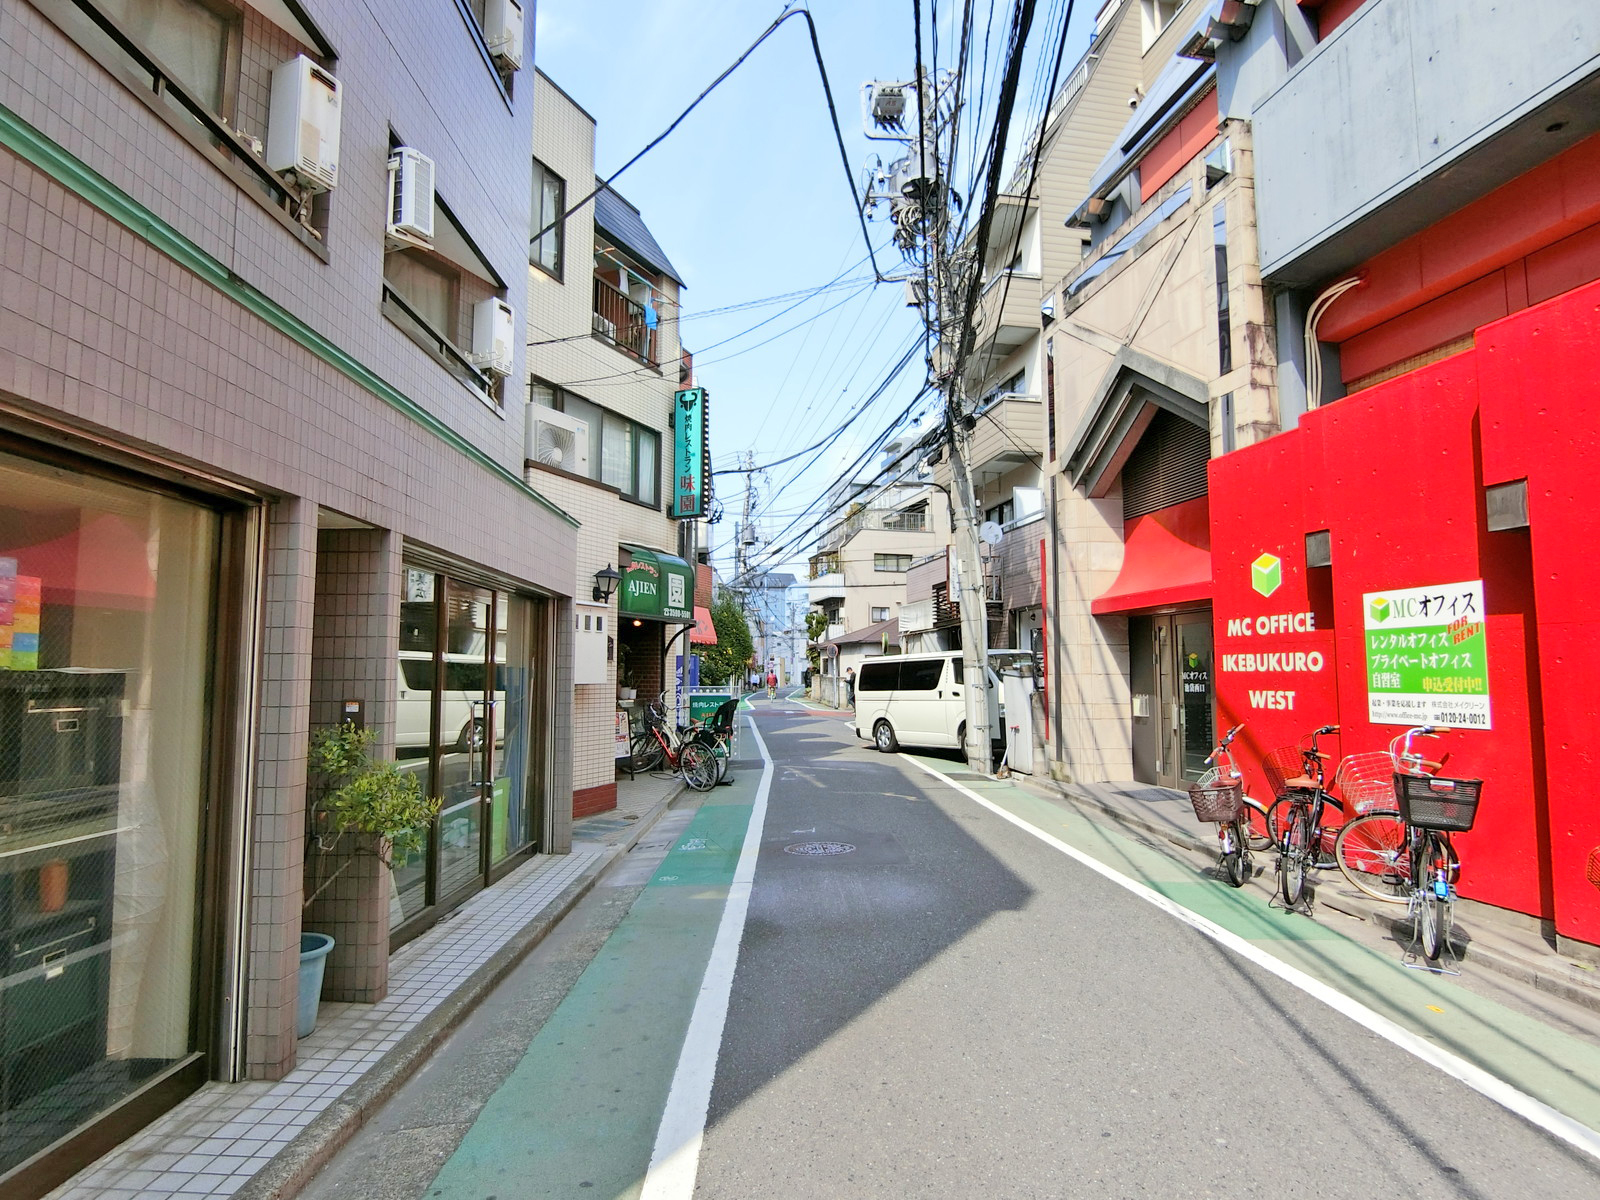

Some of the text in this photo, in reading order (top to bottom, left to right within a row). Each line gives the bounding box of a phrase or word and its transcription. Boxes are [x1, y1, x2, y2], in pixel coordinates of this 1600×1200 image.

[680, 414, 696, 514] 焼肉レストラン 味園
[628, 580, 657, 597] AJIEN
[1392, 592, 1476, 619] MCオフィス
[1227, 612, 1315, 637] MC OFFICE
[1447, 615, 1468, 634] FOR
[1453, 621, 1481, 645] RENT
[1371, 632, 1450, 650] レンタルオフィス
[1222, 651, 1324, 672] IKEBUKURO
[1371, 652, 1473, 669] プライベートオフィス
[1372, 672, 1401, 689] 自習室
[1248, 690, 1296, 710] WEST
